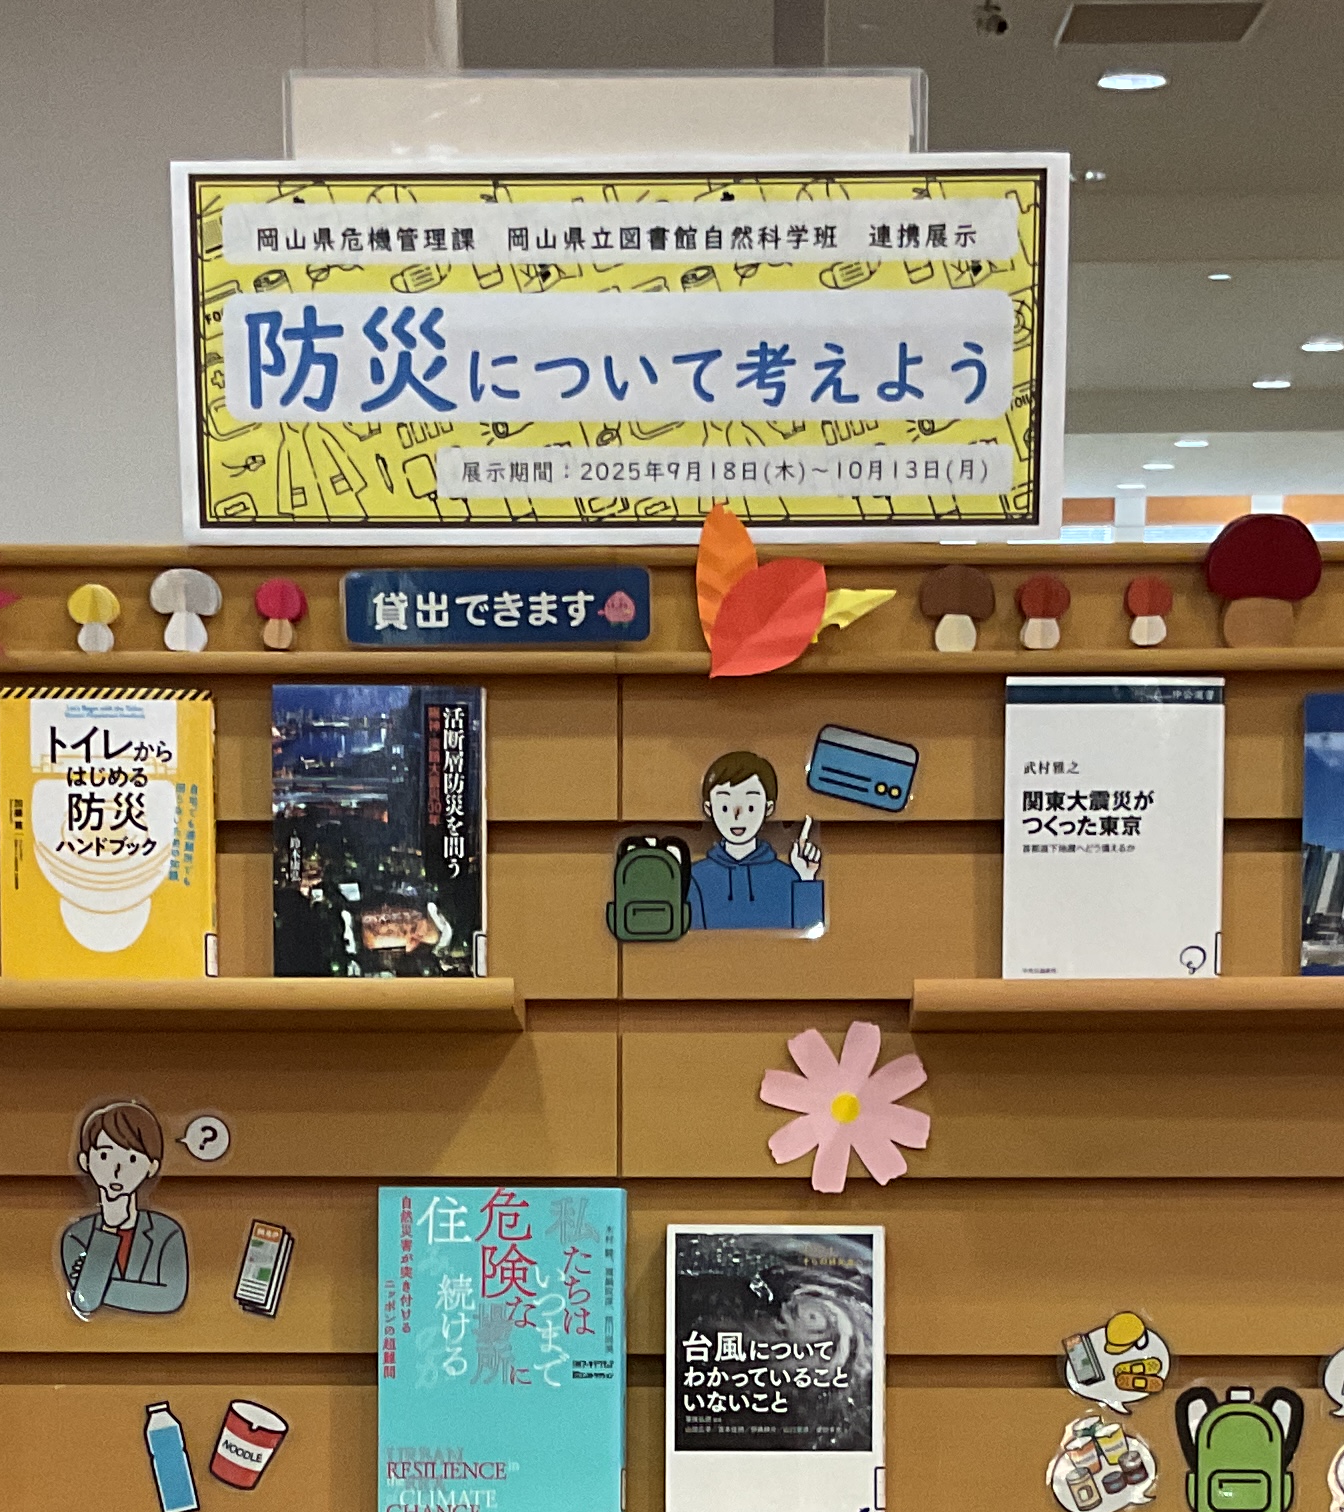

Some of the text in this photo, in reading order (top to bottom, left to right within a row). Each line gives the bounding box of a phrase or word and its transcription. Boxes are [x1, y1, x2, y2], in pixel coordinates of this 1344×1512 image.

[256, 223, 977, 253] 岡山県危機管理課 岡山県立図書館自然科学班 連携展示
[245, 304, 989, 413] 防災について考えよう
[372, 591, 594, 632] 貸出できます
[46, 726, 173, 763] トイレから
[67, 767, 148, 788] はじめる
[1024, 761, 1080, 776] 武村雅之
[443, 707, 465, 879] 活断層防災を問う
[1022, 790, 1155, 812] 関東大震災が
[67, 794, 148, 832] 防災
[1022, 815, 1143, 836] つくった東京
[56, 836, 157, 857] ハンドブック
[400, 1196, 413, 1333] 自然災害が突き付ける
[682, 1332, 834, 1362] 台風について
[684, 1367, 849, 1389] わかっていること
[683, 1392, 788, 1414] いないこと
[221, 1438, 264, 1464] NOODLE
[387, 1461, 507, 1480] RESILIENCE
[399, 1489, 497, 1508] CLIMATE
